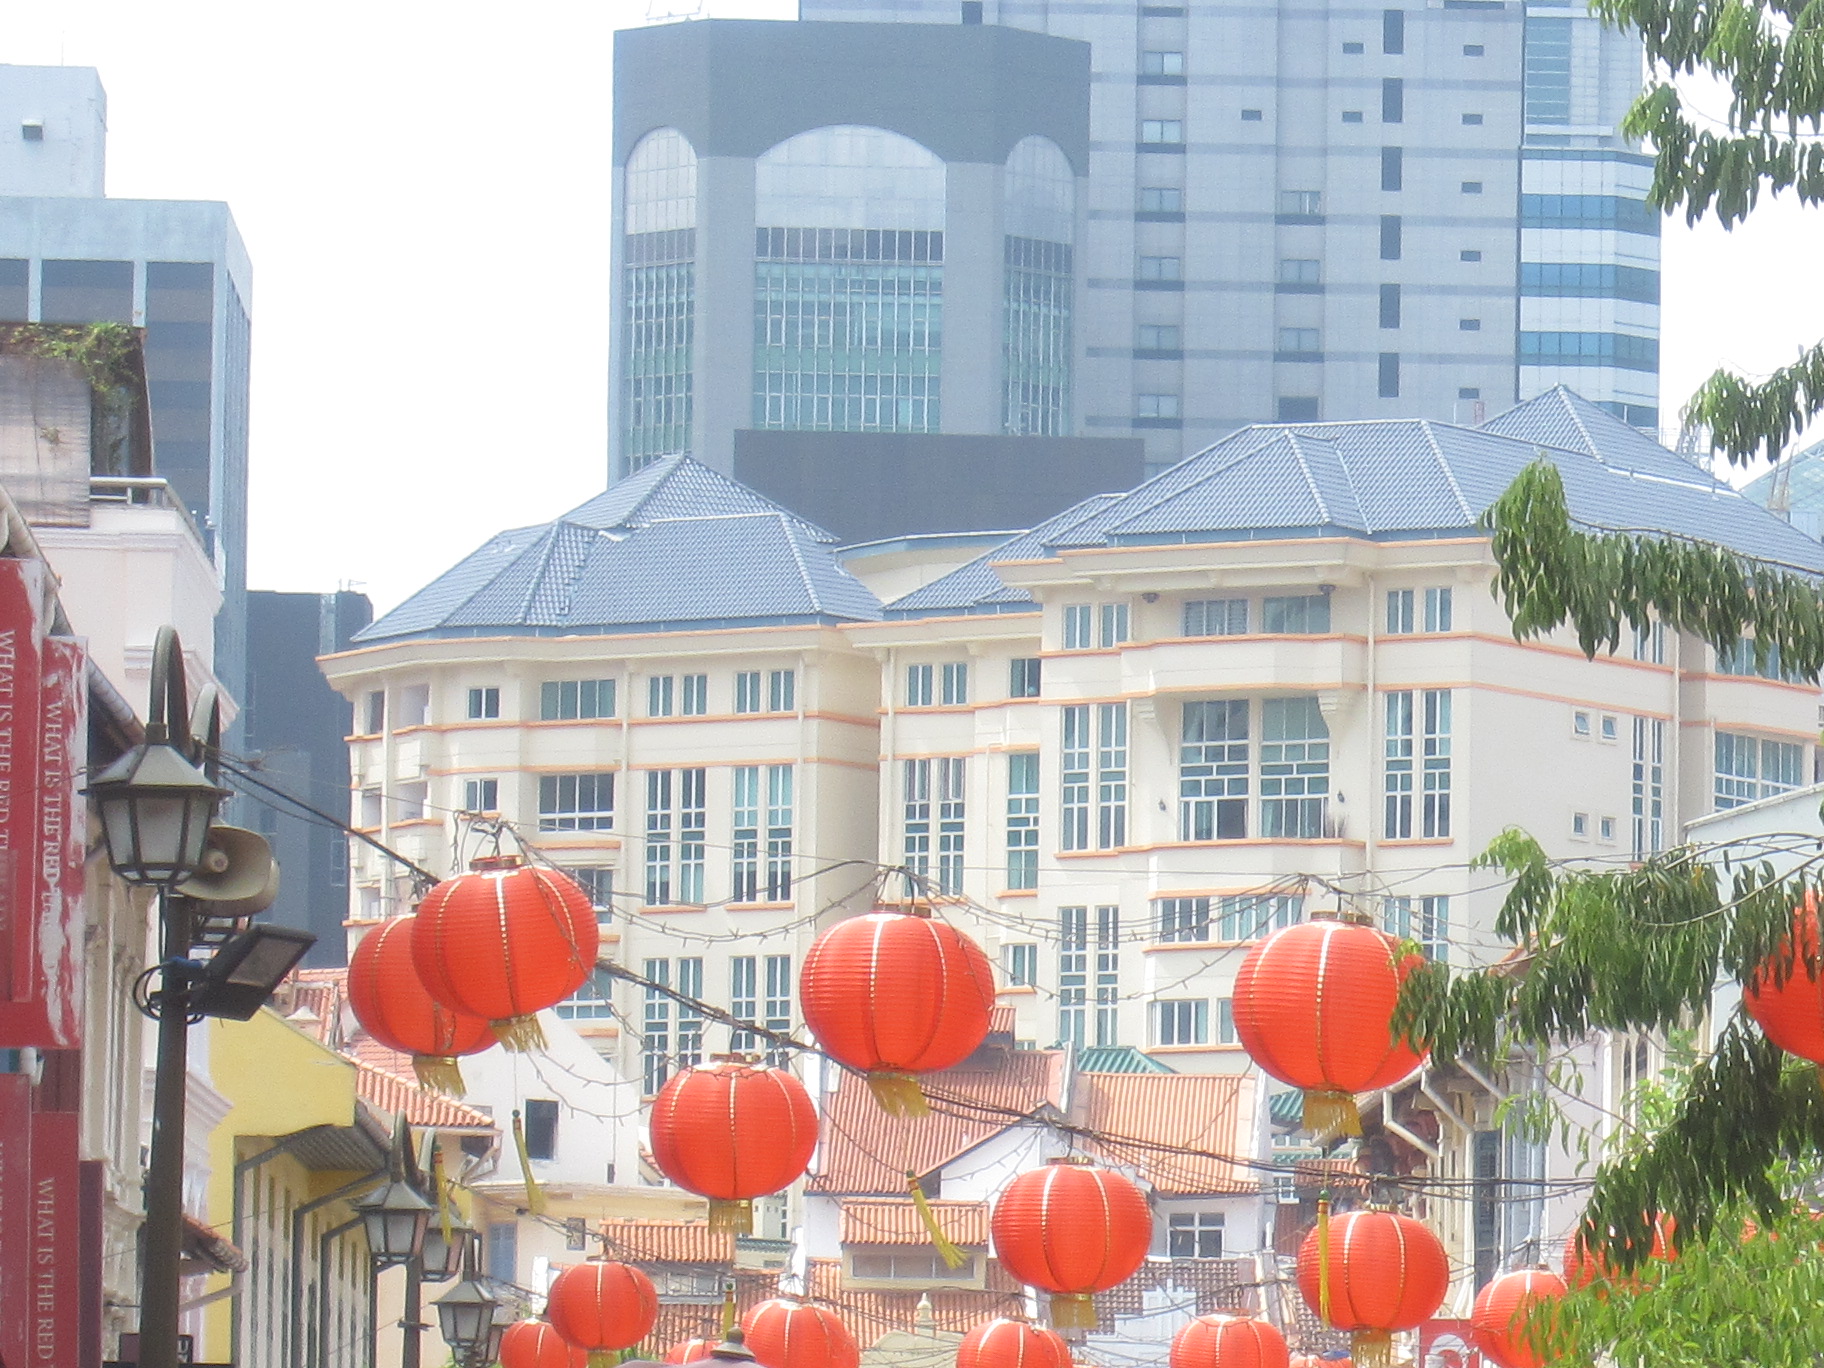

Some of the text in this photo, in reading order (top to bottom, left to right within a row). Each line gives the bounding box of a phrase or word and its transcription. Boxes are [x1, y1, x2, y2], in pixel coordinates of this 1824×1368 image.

[44, 702, 63, 763] WHAT
[43, 792, 62, 837] THE
[36, 1177, 55, 1238] WHAT
[36, 1248, 55, 1266] IS
[36, 1272, 55, 1313] THE
[36, 1317, 54, 1360] RED
